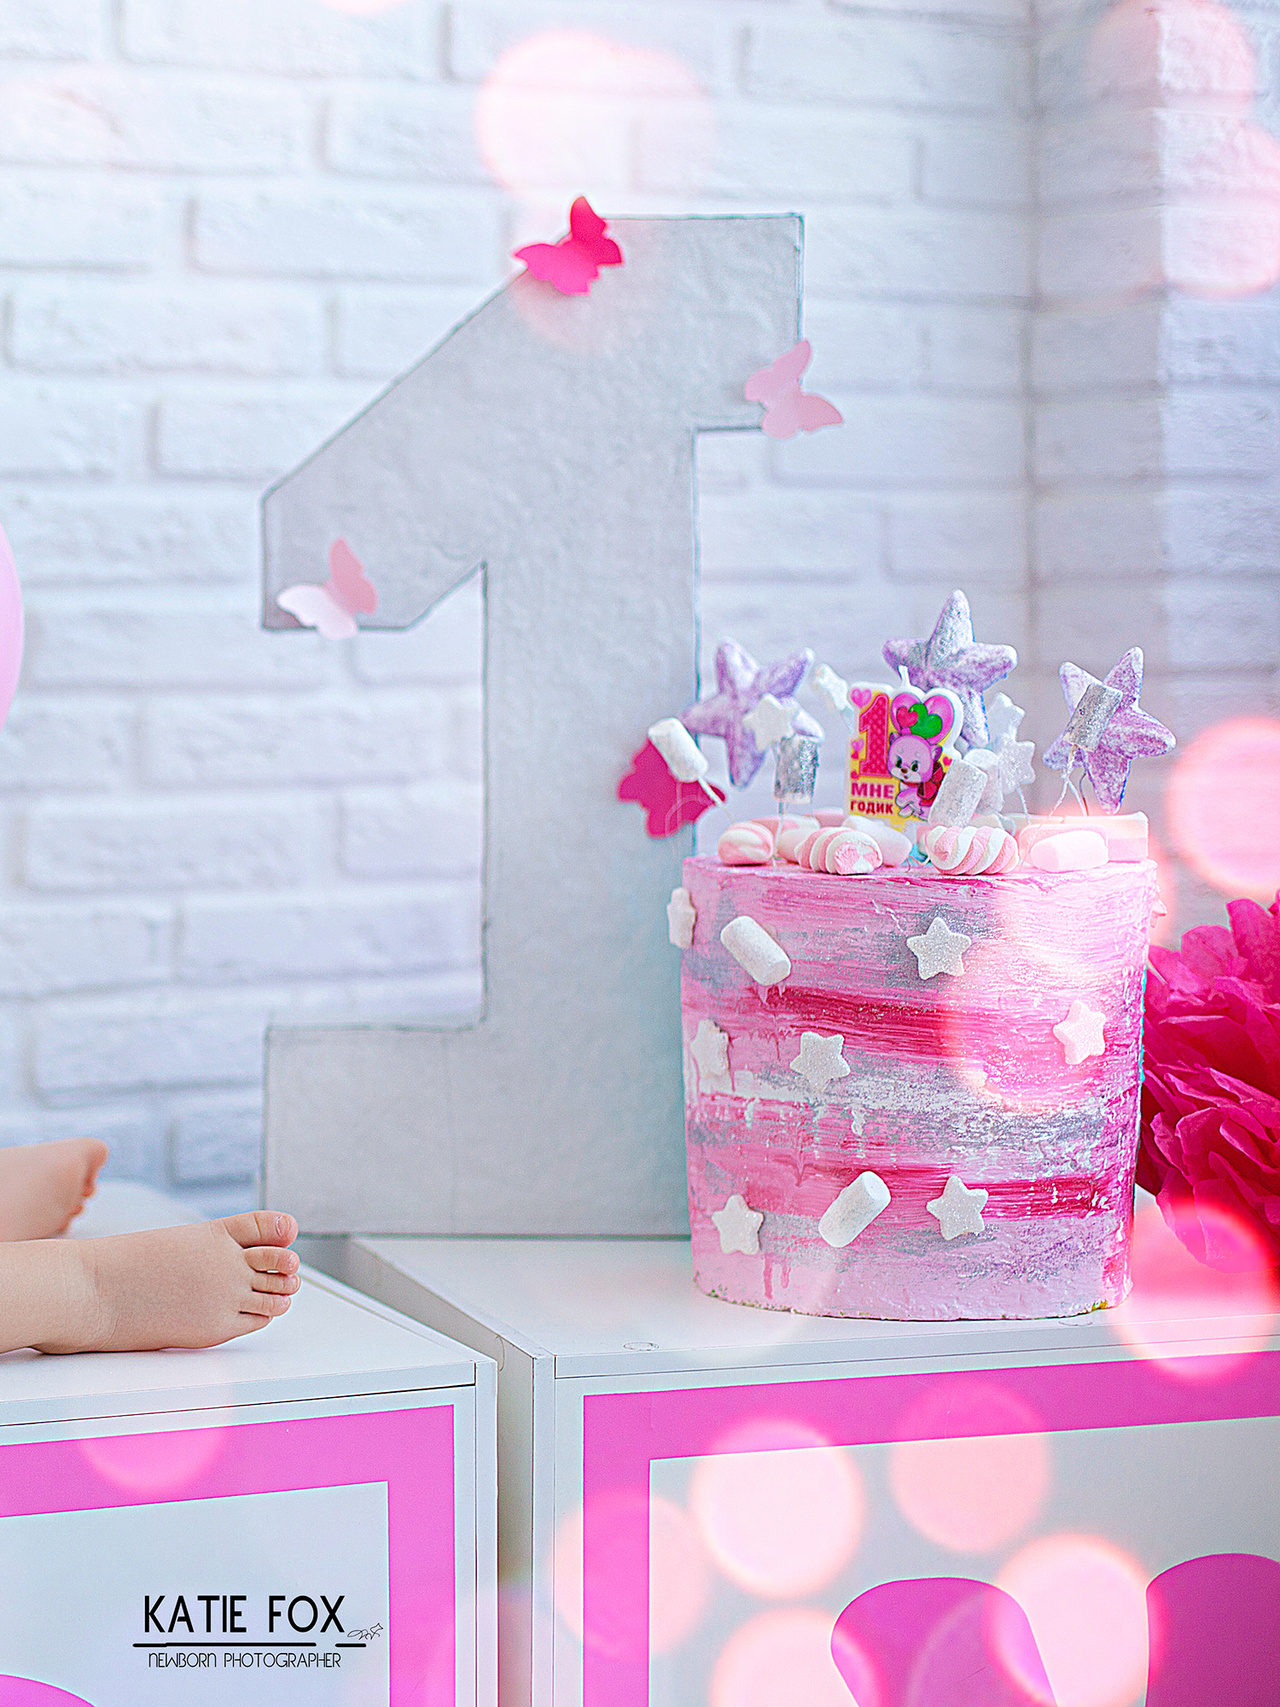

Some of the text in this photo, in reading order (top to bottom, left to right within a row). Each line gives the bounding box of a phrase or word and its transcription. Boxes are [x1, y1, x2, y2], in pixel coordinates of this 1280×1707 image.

[261, 211, 804, 1238] 1
[858, 693, 892, 778] 1
[850, 782, 895, 799] МНЕ
[850, 800, 894, 815] ГОДИК
